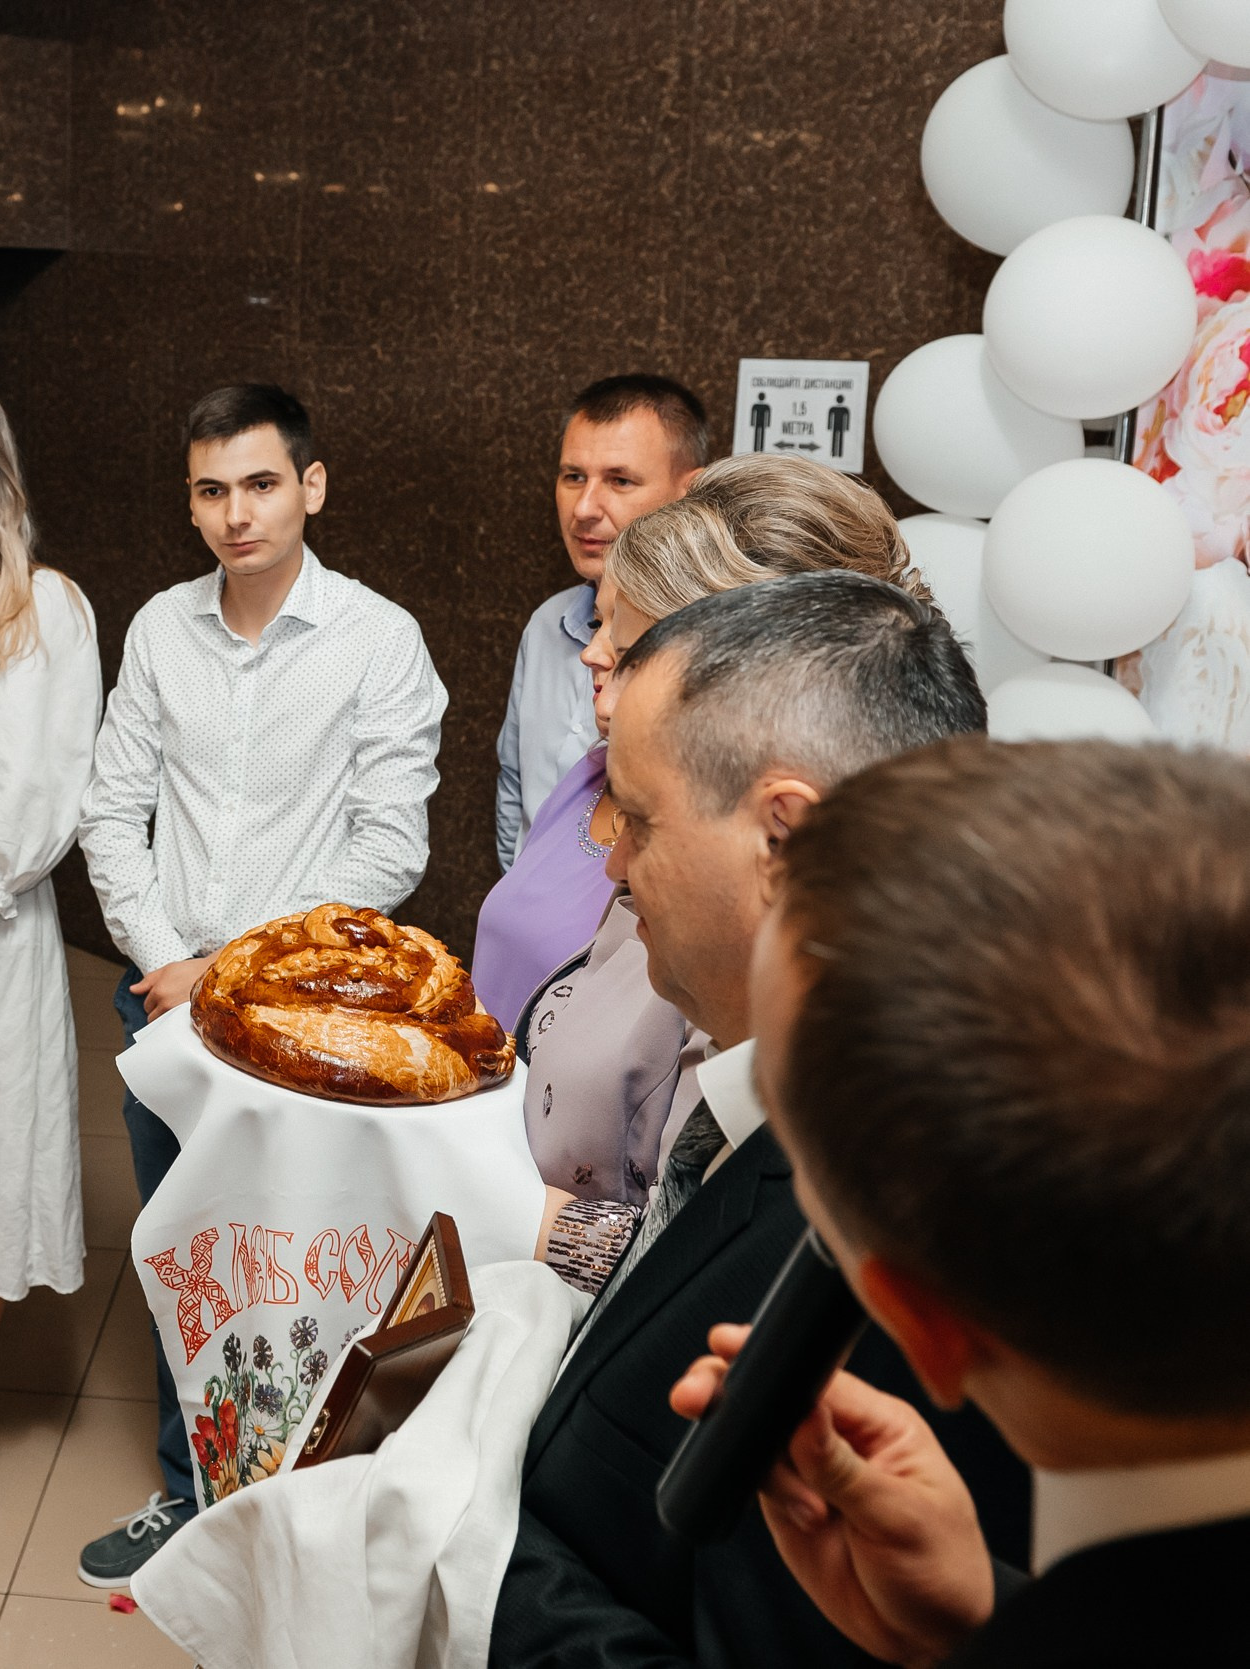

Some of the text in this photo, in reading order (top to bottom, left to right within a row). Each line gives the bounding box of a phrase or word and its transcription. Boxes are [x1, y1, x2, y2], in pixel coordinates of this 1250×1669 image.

[803, 378, 853, 390] ДИСТАНЦИЮ
[782, 421, 814, 435] МЕТРА
[143, 1223, 299, 1366] ХЛЕБ
